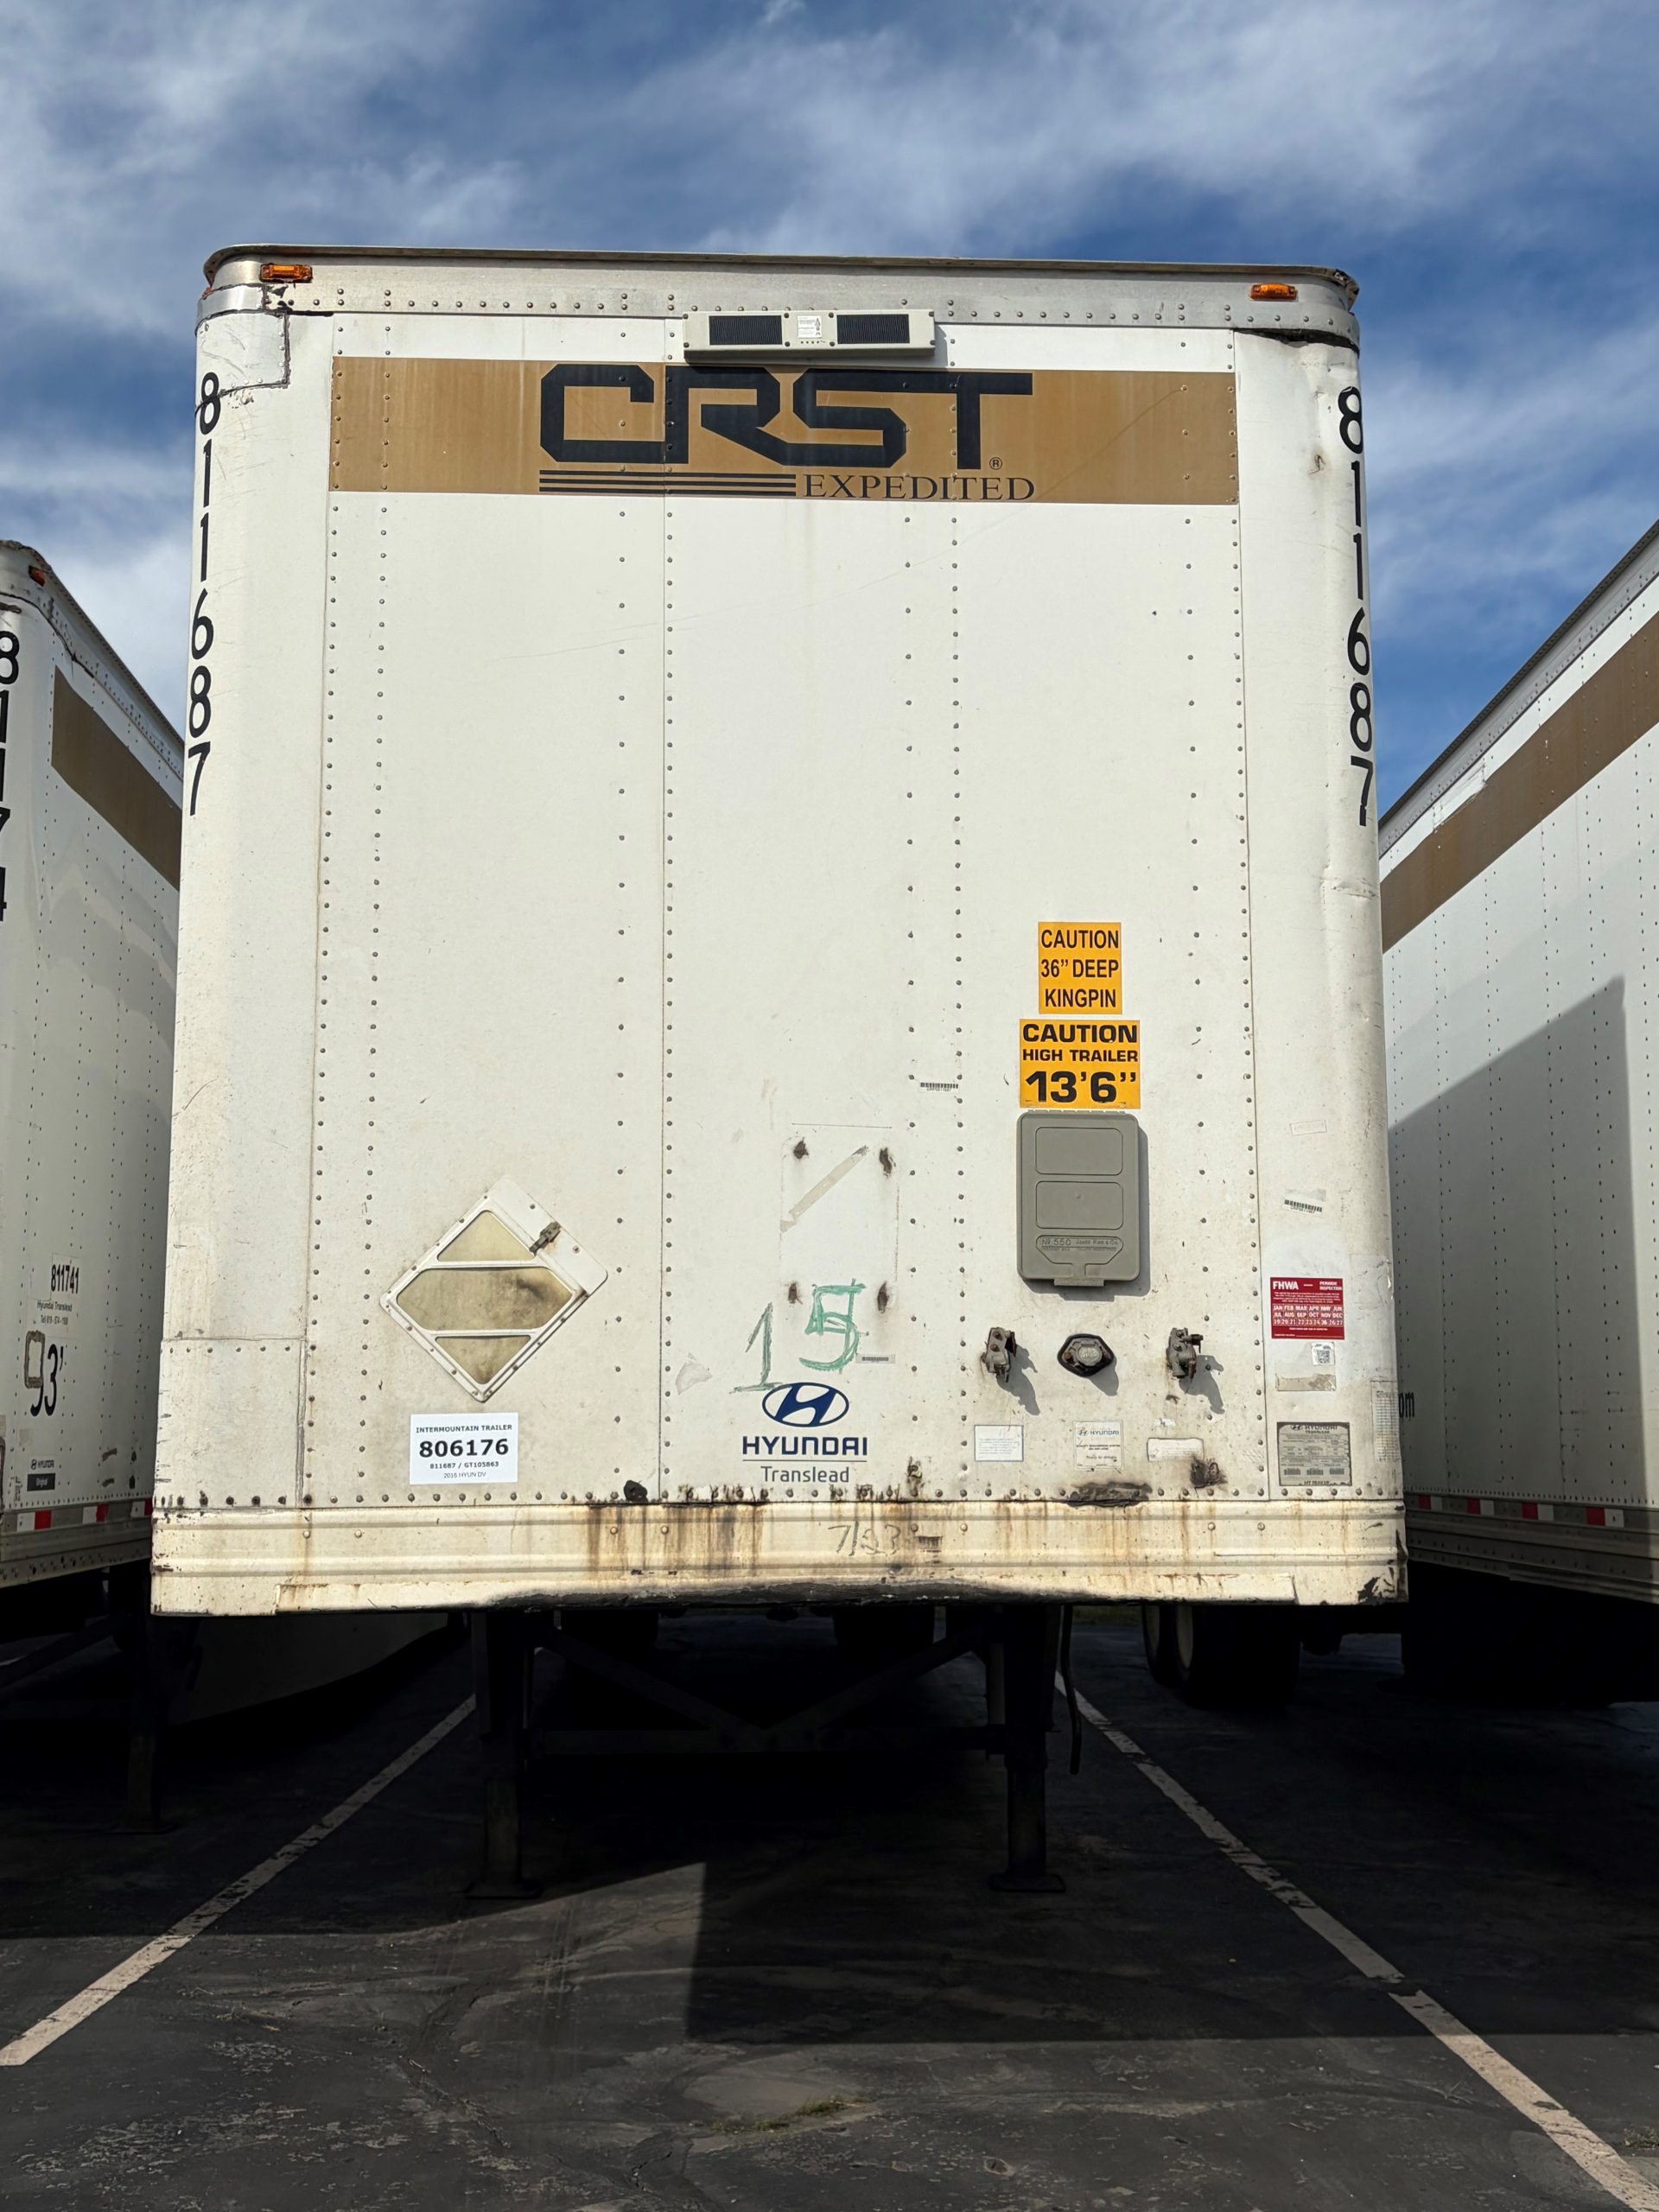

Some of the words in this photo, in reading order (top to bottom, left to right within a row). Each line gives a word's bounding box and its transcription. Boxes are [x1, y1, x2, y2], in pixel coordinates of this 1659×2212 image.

[540, 364, 1033, 469] CRST
[804, 474, 1034, 500] EXPEDITED
[188, 372, 220, 817] 811687
[1338, 386, 1374, 828] 811687
[1041, 929, 1119, 949] CAUTION
[1072, 959, 1119, 978] DEEP
[1045, 988, 1116, 1007] KINGPIN
[1022, 1023, 1137, 1043] CAUTION
[1022, 1049, 1063, 1061] HIGH
[1070, 1050, 1138, 1062] TRAILER
[51, 1264, 79, 1294] 811741
[1272, 1281, 1299, 1290] FHWA
[416, 1425, 479, 1433] INTERMOUNTAIN
[419, 1438, 509, 1458] 806176
[742, 1436, 868, 1456] HYUNDAI
[760, 1465, 849, 1484] Translead
